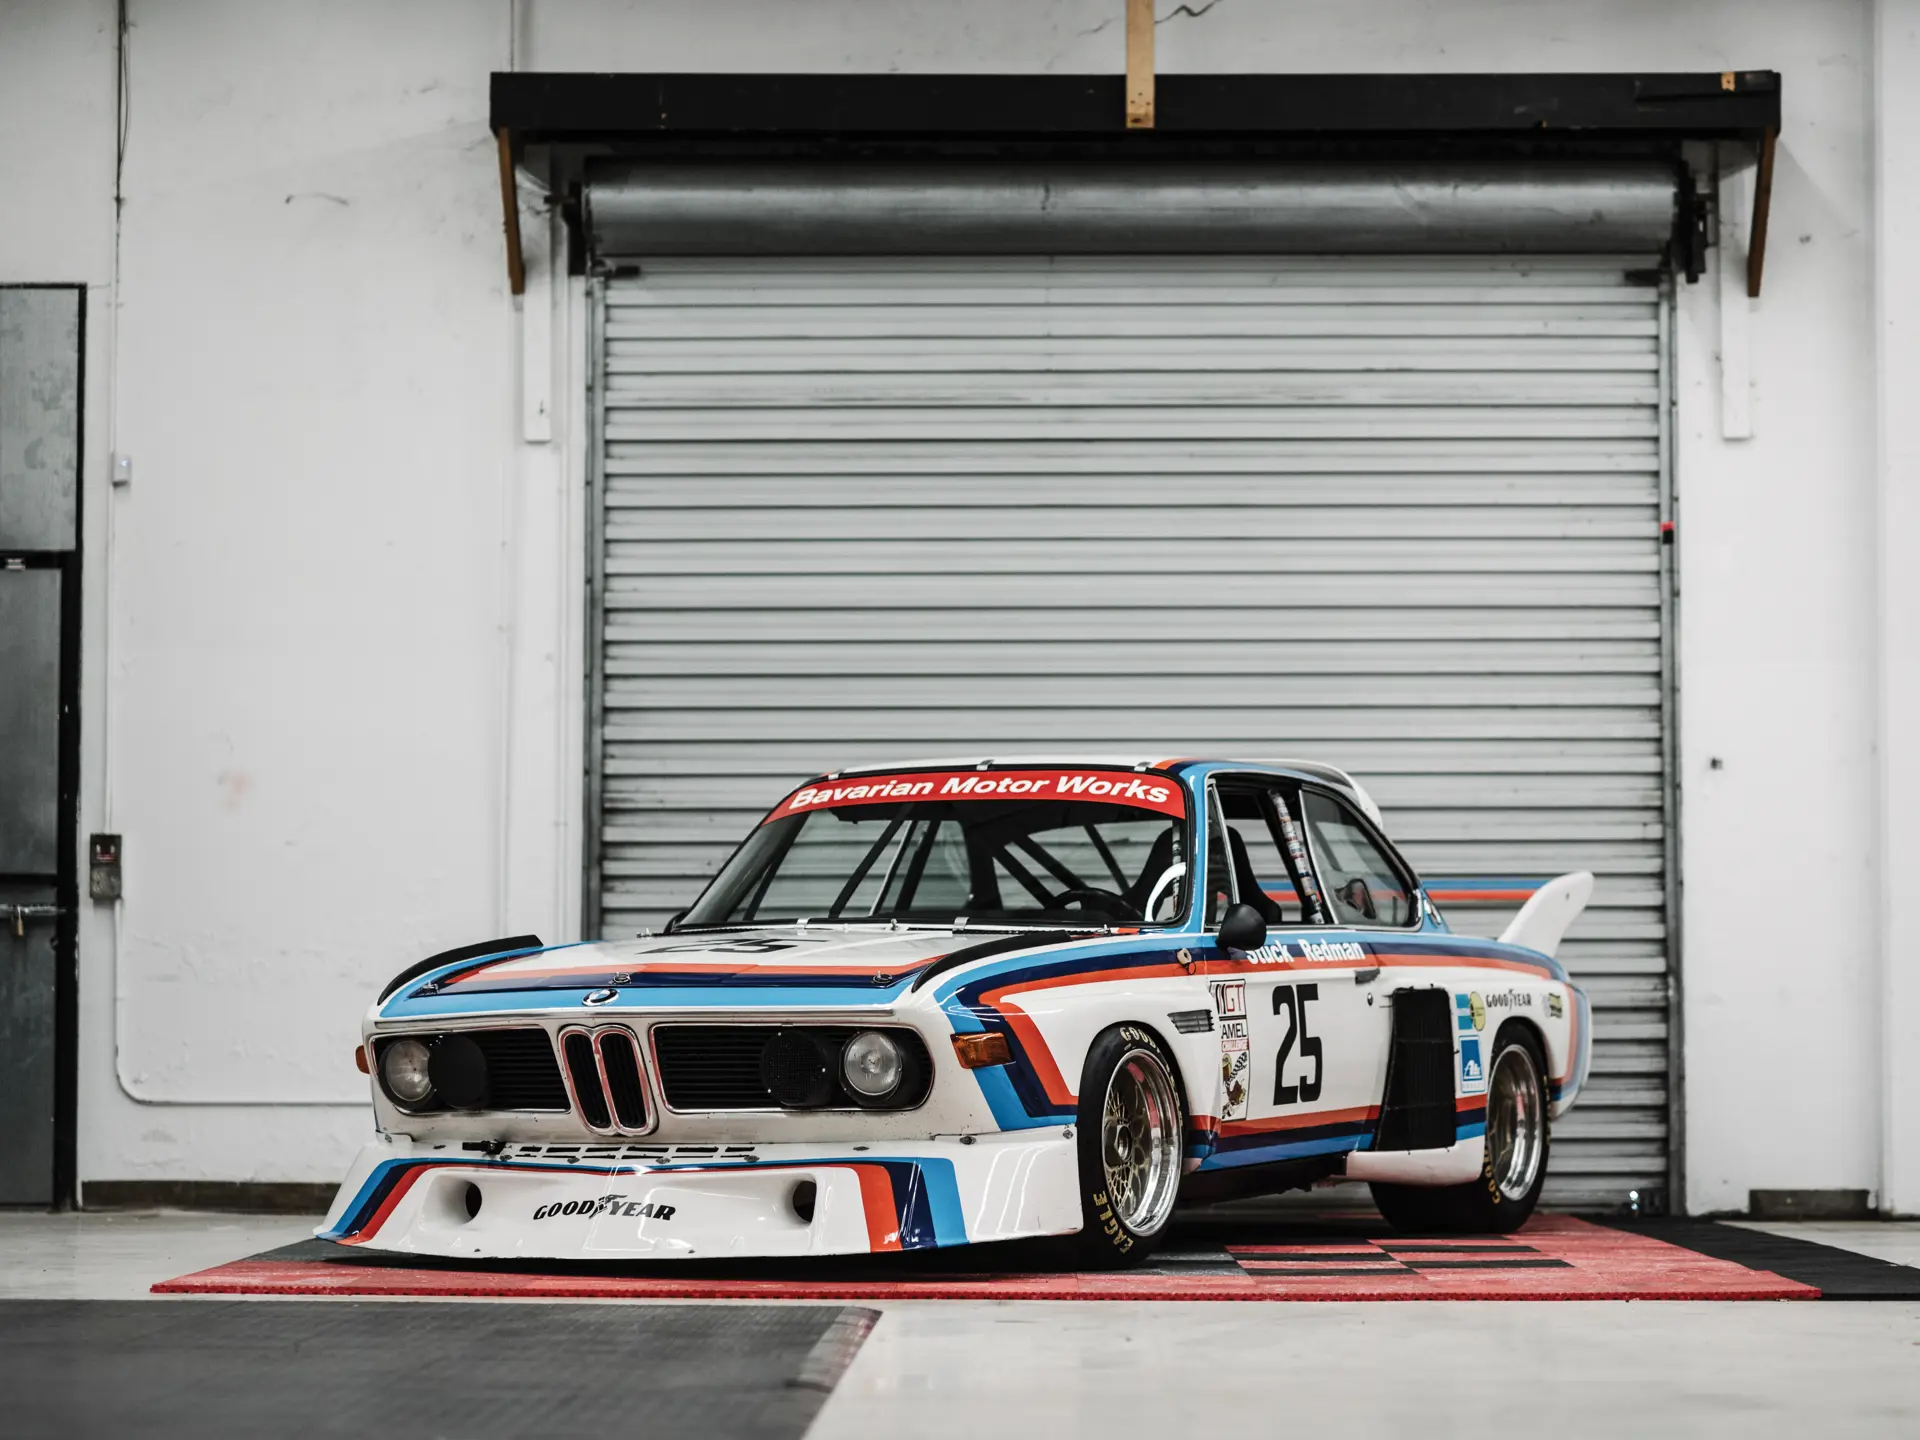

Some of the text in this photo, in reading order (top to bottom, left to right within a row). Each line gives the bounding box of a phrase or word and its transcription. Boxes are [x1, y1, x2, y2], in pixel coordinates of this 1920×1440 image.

[789, 776, 1170, 809] Bavarian Motor Works
[1245, 938, 1366, 965] Stuck Redman
[1220, 1022, 1247, 1040] AMEL
[1272, 983, 1323, 1106] 25
[533, 1195, 676, 1221] GOODYEAR
[1093, 1190, 1134, 1255] EAGLE
